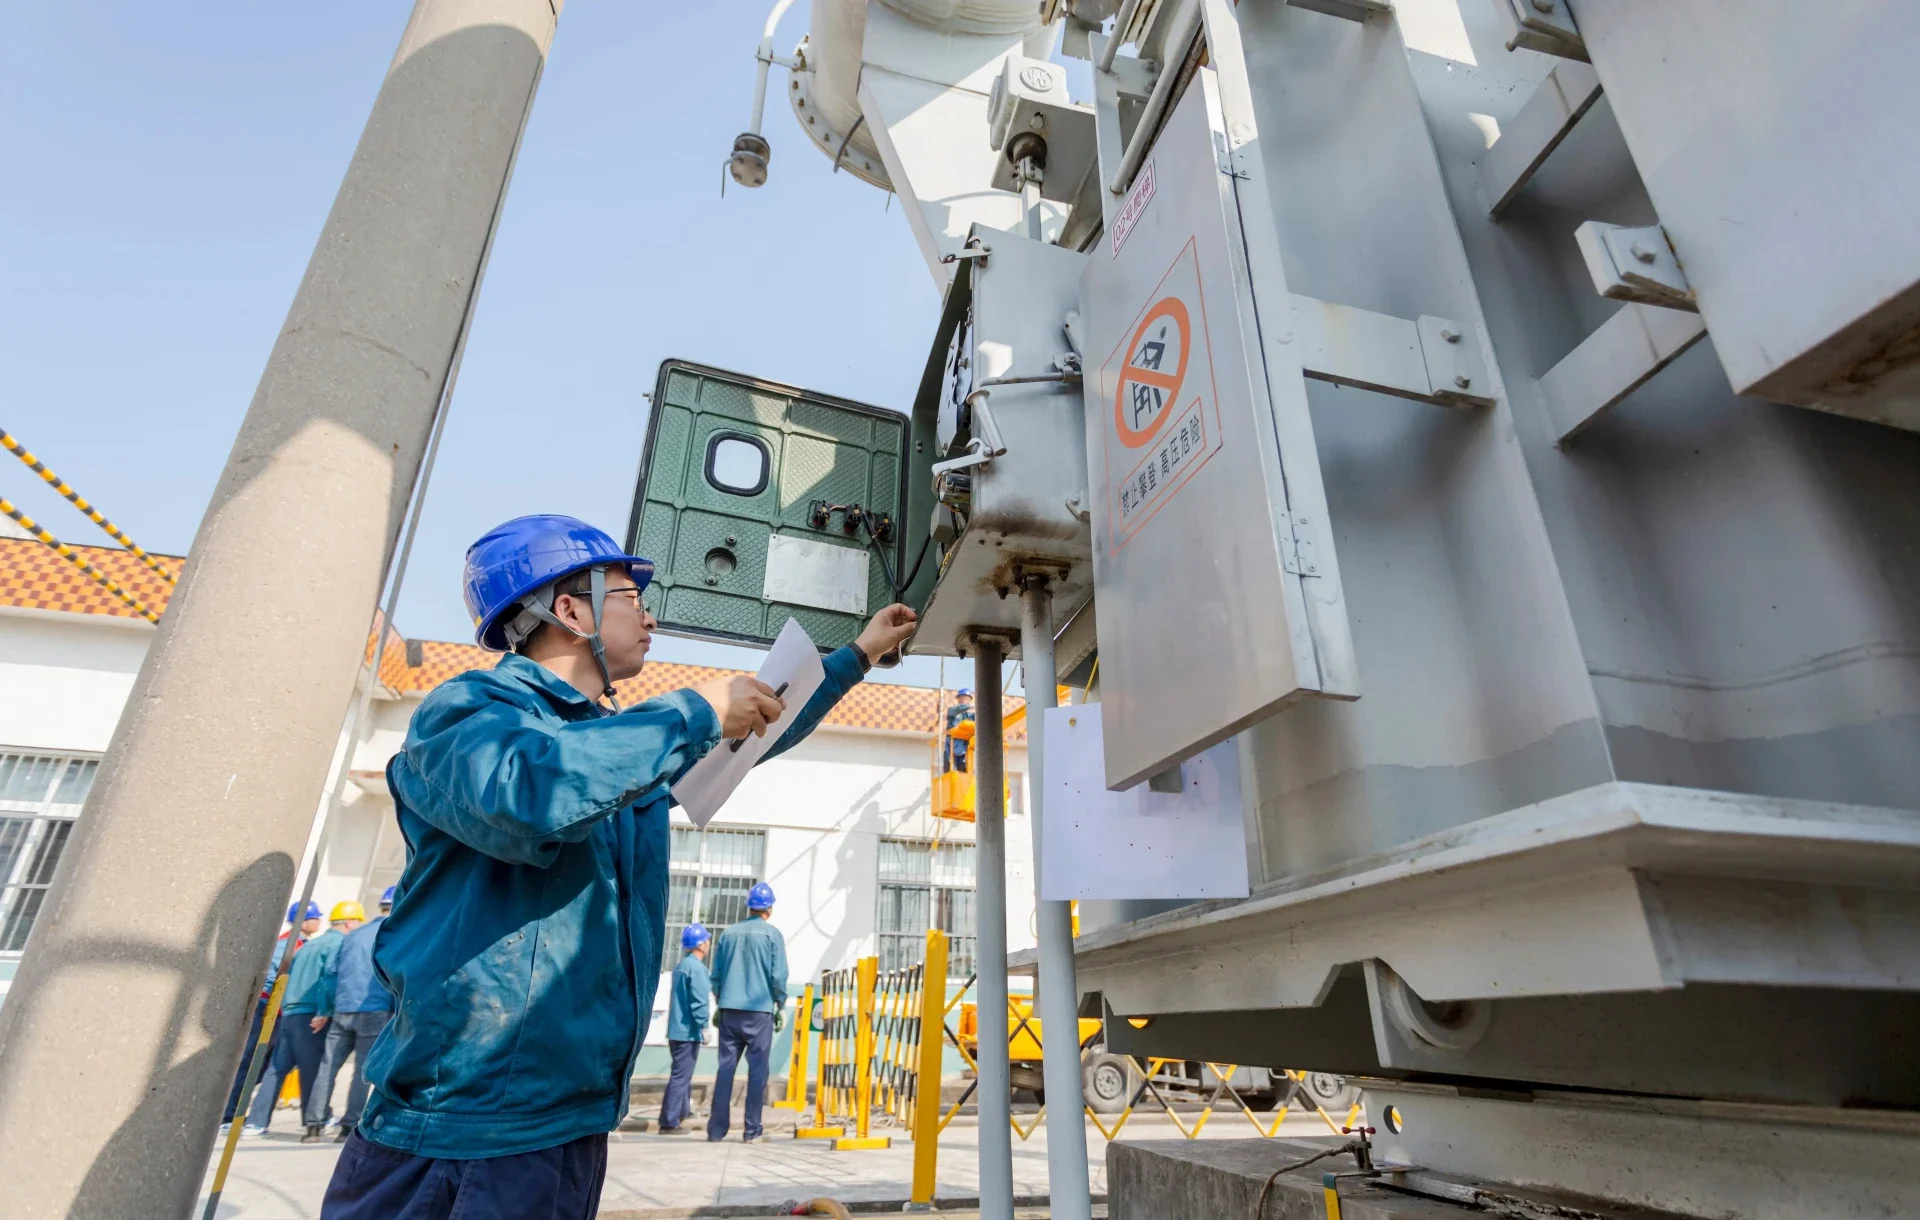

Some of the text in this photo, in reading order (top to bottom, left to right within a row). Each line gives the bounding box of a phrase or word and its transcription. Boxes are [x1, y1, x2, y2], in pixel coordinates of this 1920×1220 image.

[1121, 415, 1201, 518] 禁止攀登 高压危险
